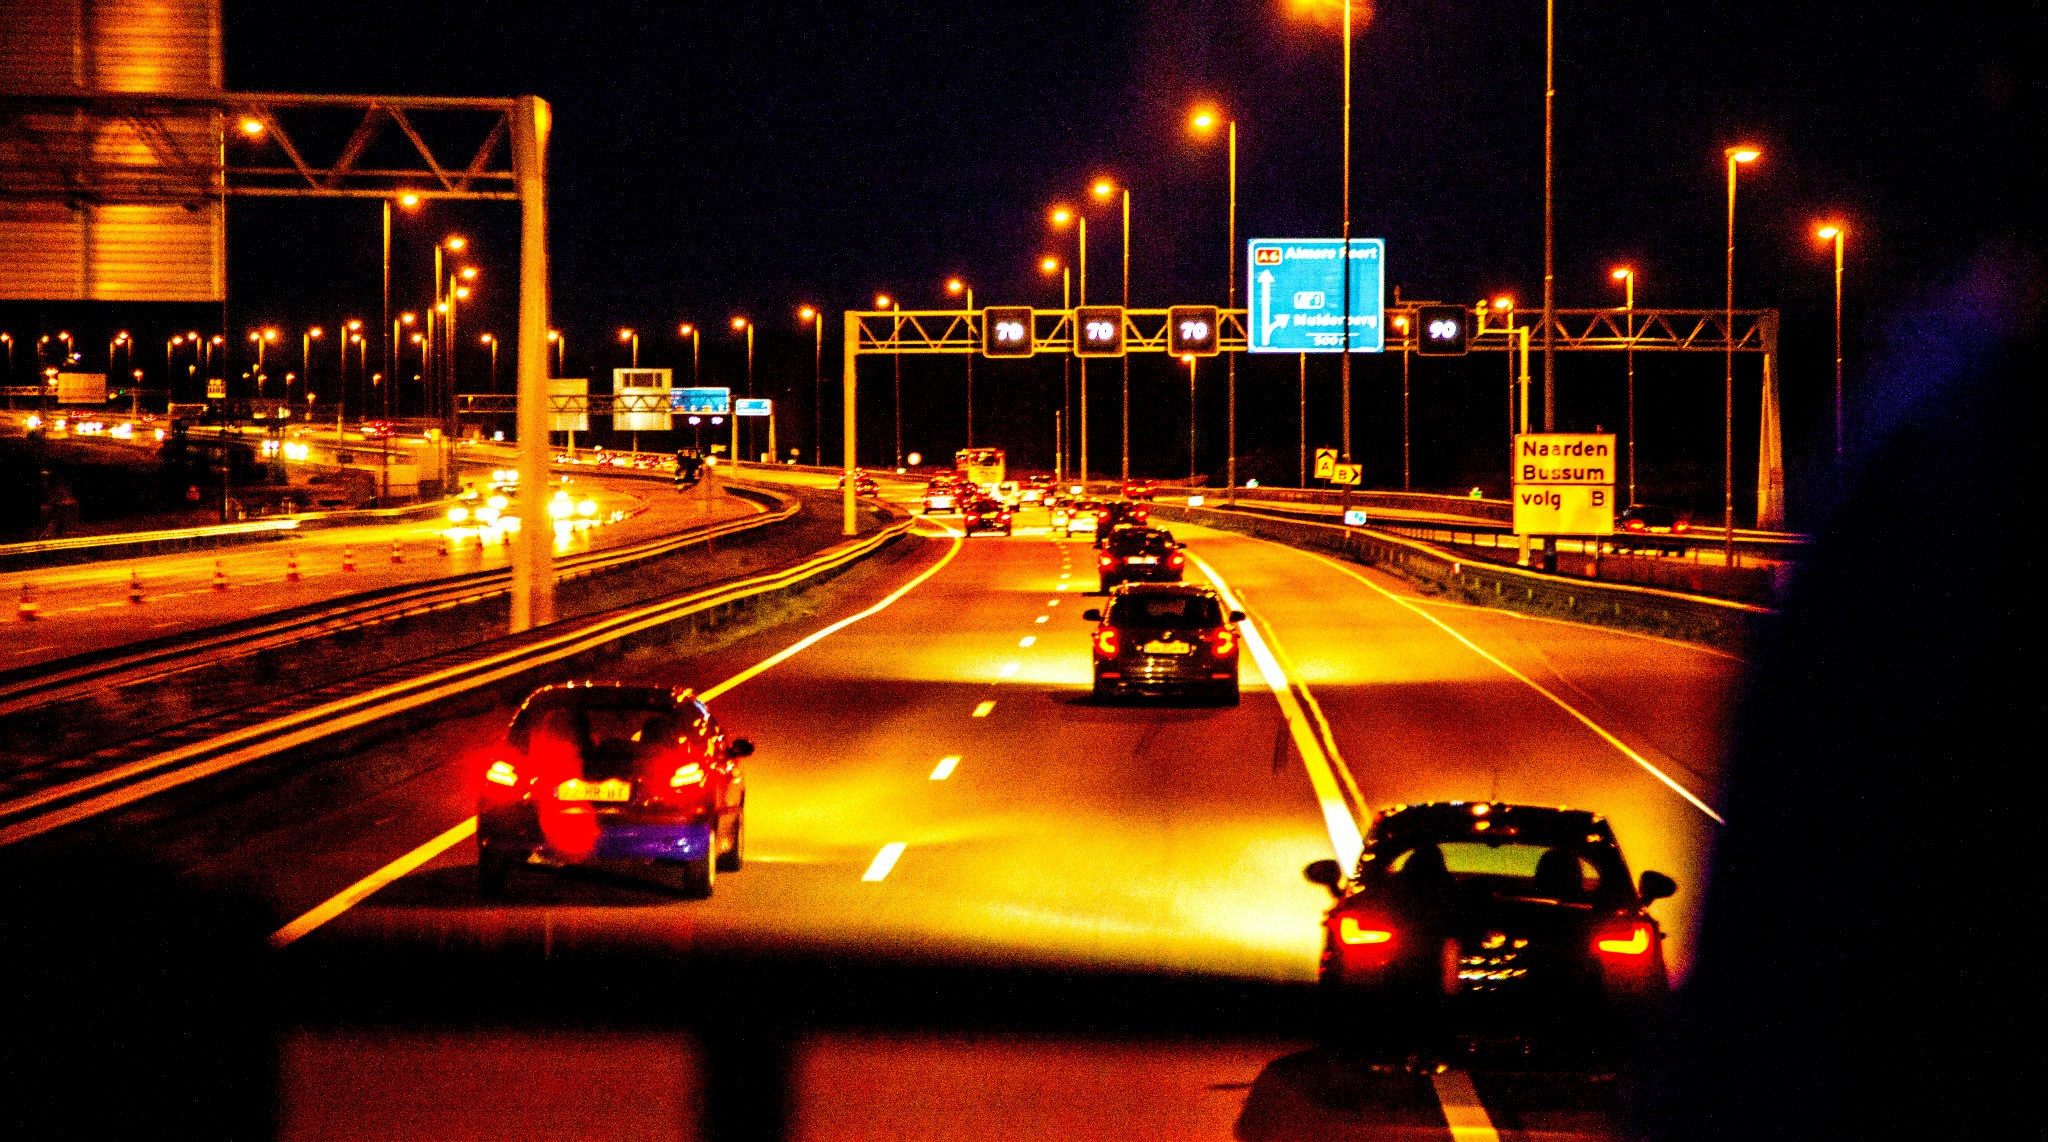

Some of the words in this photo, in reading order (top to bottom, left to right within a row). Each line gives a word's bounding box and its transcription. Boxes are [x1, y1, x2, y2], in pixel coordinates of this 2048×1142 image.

[1259, 251, 1280, 262] A6
[995, 322, 1024, 341] 70
[1086, 321, 1114, 340] 70
[1180, 321, 1208, 340] 70
[1429, 320, 1458, 339] 90
[1523, 440, 1608, 457] Naarden
[1338, 469, 1347, 480] B
[1523, 464, 1604, 480] Bussum
[1521, 490, 1561, 511] volg
[1591, 490, 1605, 507] B
